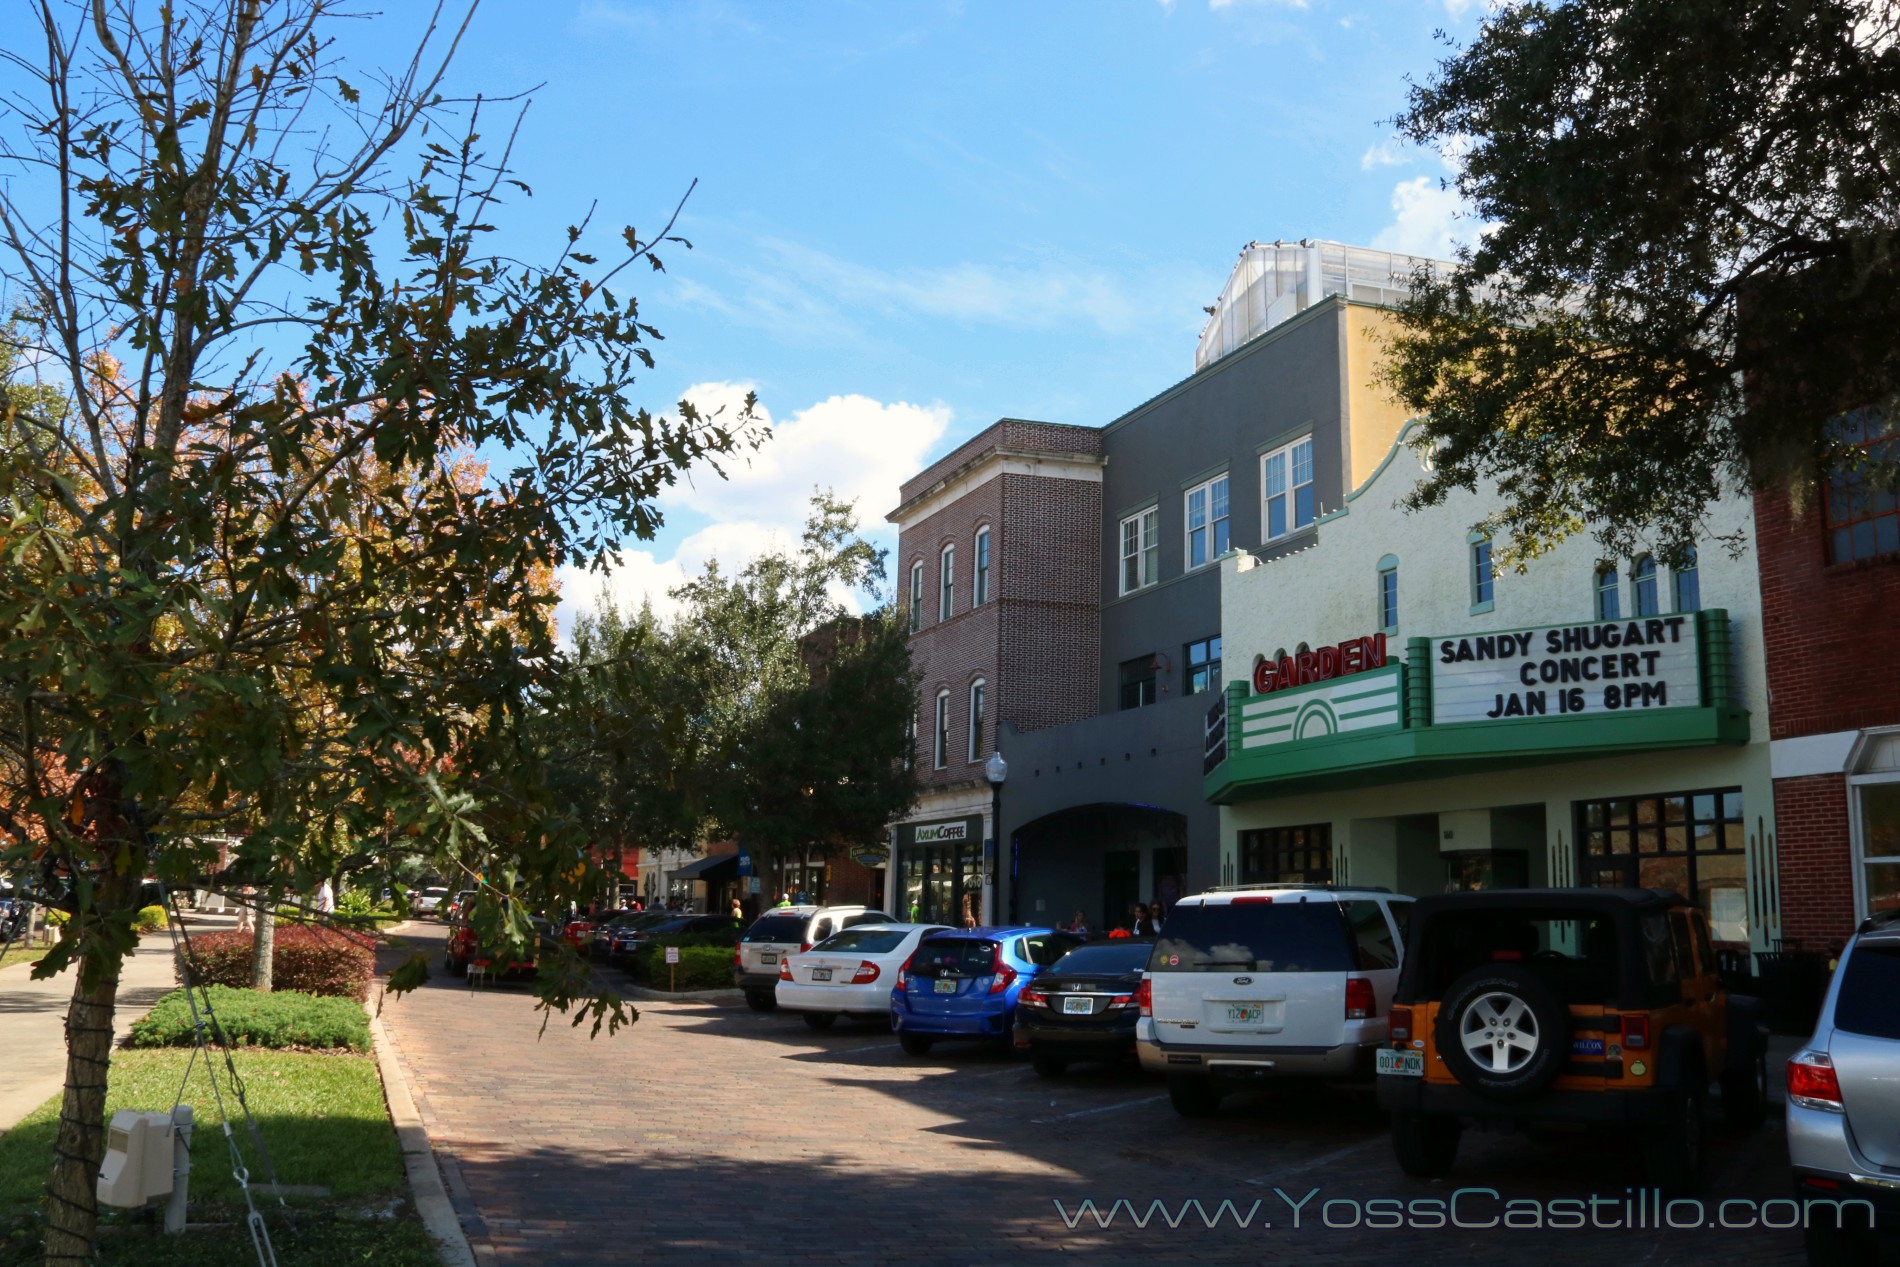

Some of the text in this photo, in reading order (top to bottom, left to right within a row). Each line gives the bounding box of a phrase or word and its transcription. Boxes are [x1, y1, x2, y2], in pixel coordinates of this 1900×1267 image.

[1440, 617, 1684, 663] SANDY SHUGART
[1254, 633, 1386, 694] GARDEN
[1520, 651, 1661, 686] CONCERT
[1487, 681, 1666, 718] JAN 16 8PM
[1380, 1056, 1421, 1070] 001 NDK
